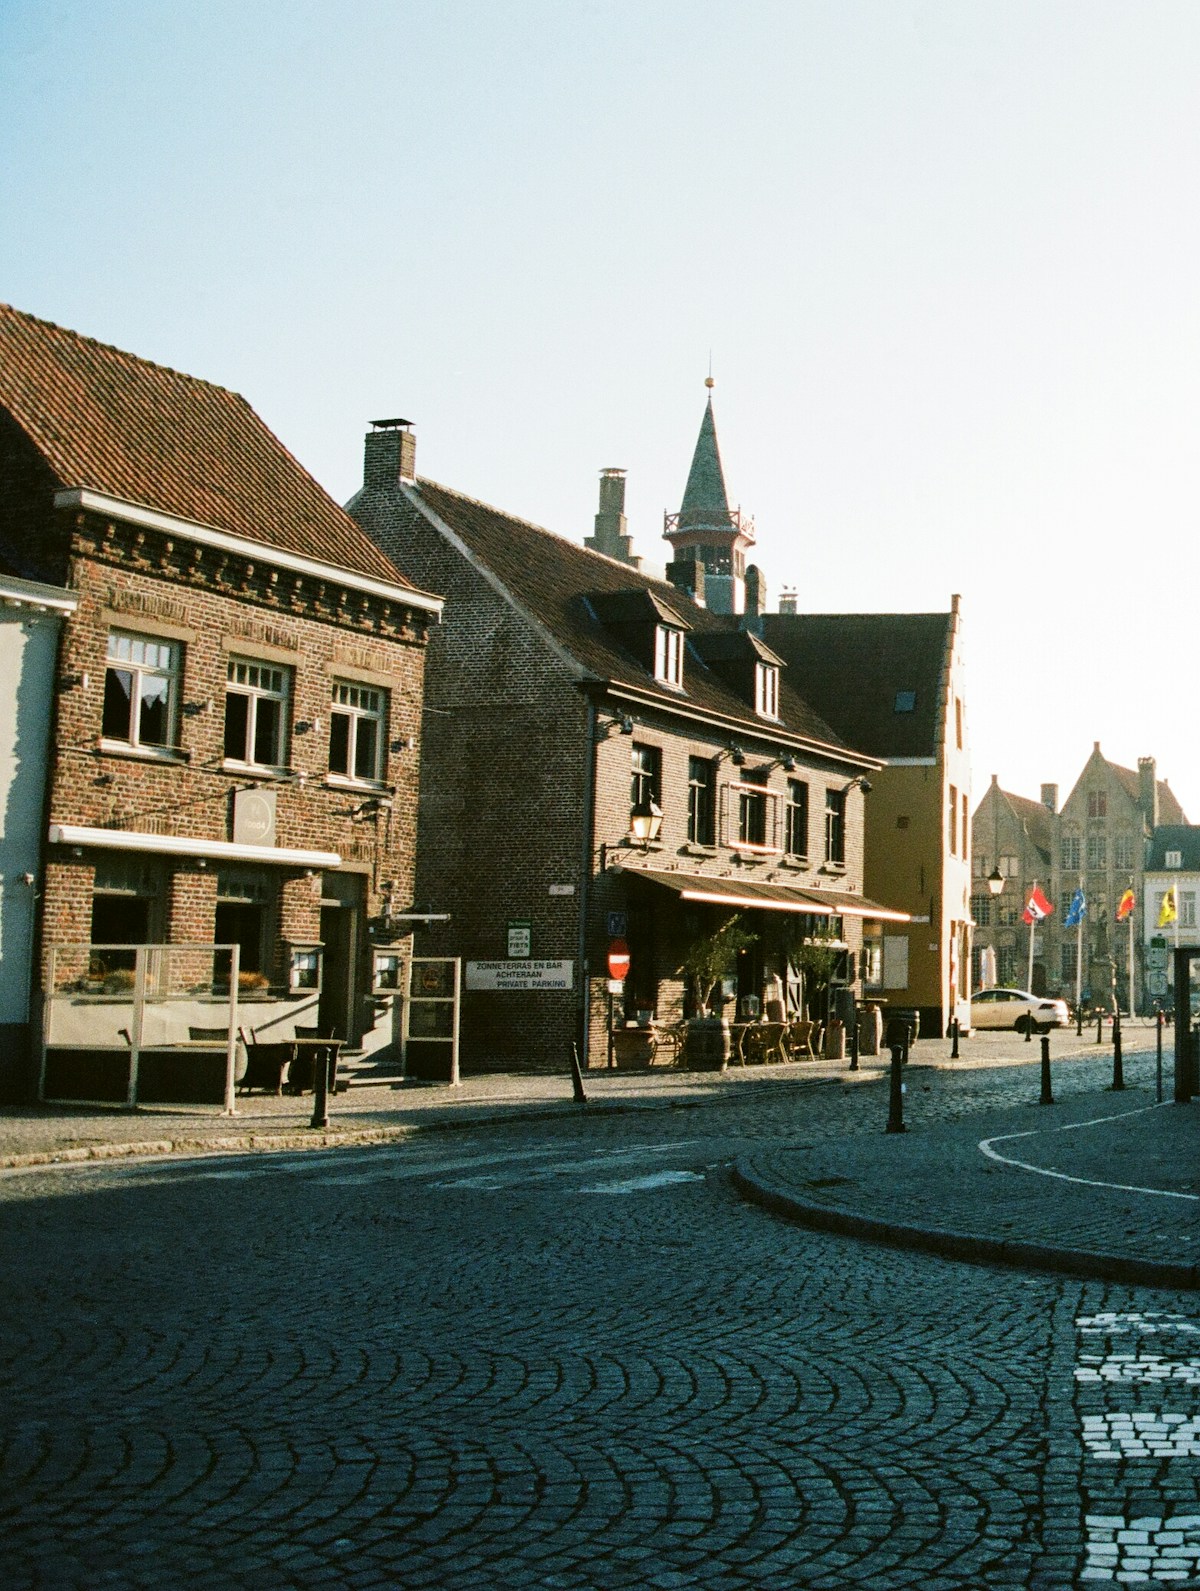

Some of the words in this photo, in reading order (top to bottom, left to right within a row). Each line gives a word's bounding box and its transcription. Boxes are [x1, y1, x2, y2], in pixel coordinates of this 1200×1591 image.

[476, 962, 532, 970] ZONNETERRAS
[497, 980, 529, 988] PRIVATE
[532, 980, 566, 988] PARKING
